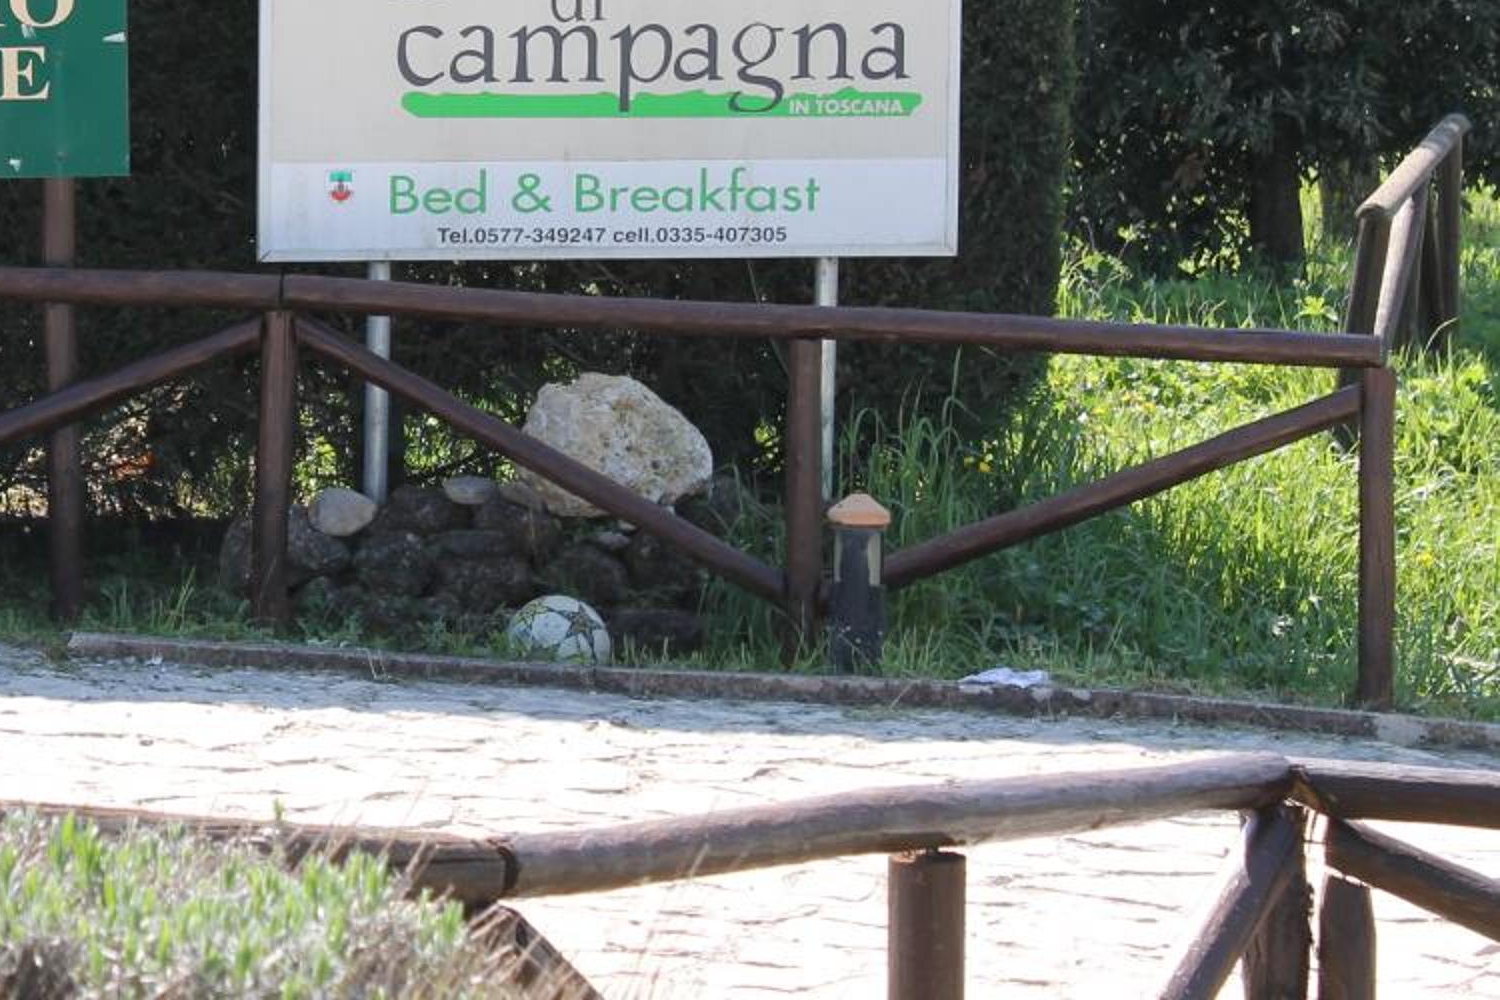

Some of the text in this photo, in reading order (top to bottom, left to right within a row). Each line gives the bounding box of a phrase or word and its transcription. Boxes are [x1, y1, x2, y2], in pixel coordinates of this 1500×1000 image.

[396, 21, 912, 113] campagna
[789, 99, 904, 115] IN TOSCANA
[388, 168, 822, 216] Bed & Breakfast
[436, 226, 788, 245] Tel.0577-349247 cell.0335-407305
